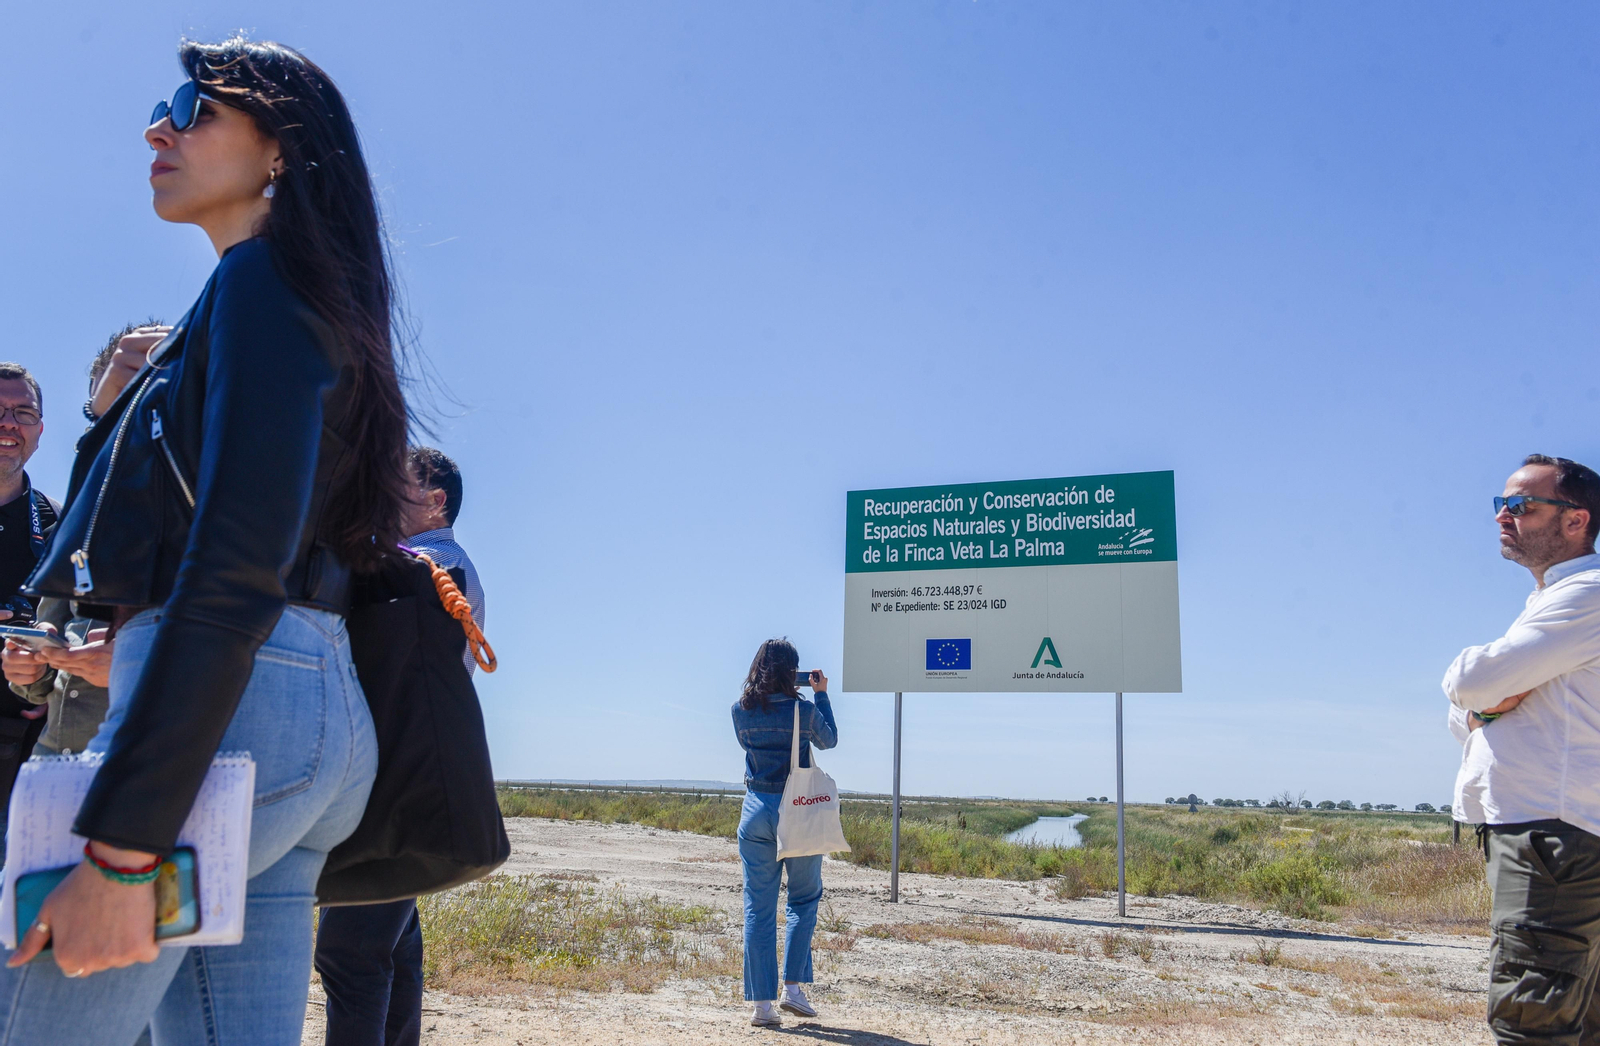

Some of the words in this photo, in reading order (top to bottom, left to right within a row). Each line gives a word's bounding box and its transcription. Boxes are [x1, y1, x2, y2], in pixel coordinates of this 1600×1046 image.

[864, 493, 963, 518] Recuperación
[969, 497, 978, 515] y
[983, 485, 1089, 510] Conservación
[1095, 484, 1115, 503] de
[31, 503, 40, 534] SONY
[864, 520, 927, 543] Espacios
[933, 516, 1006, 536] Naturales
[1011, 518, 1020, 537] y
[1026, 508, 1136, 532] Biodiversidad
[862, 545, 881, 563] de
[886, 544, 899, 562] la
[904, 543, 944, 561] Finca
[949, 541, 984, 560] Veta
[990, 540, 1008, 558] La
[1015, 538, 1065, 557] Palma
[871, 588, 909, 598] Inversión:
[911, 585, 974, 597] 46.723.448,97
[977, 585, 983, 595] €
[883, 603, 893, 612] de
[895, 601, 940, 613] Expediente:
[943, 600, 954, 610] SE
[957, 600, 988, 610] 23/024
[990, 599, 1007, 609] IGD
[1046, 670, 1085, 679] Andalucía
[793, 795, 831, 806] elCorreo
